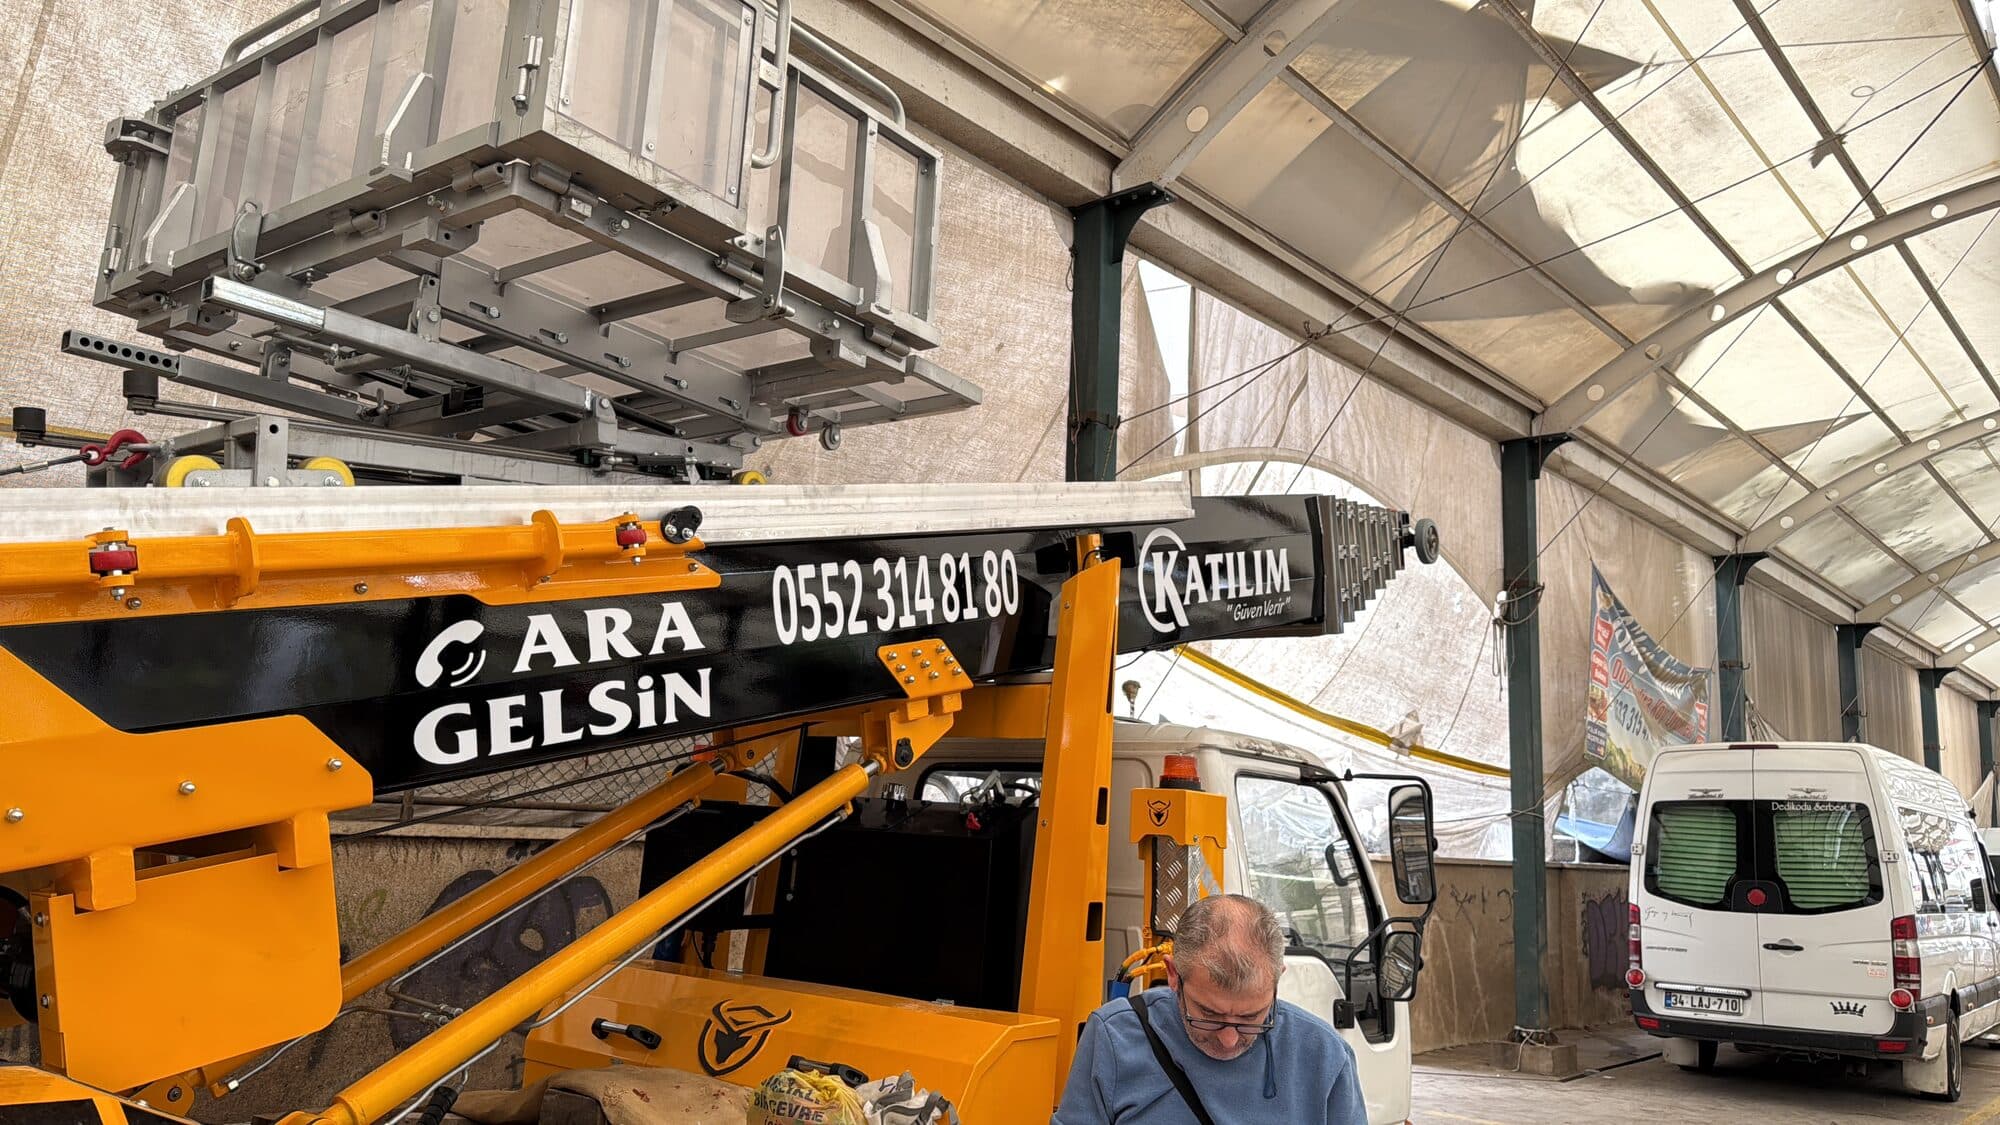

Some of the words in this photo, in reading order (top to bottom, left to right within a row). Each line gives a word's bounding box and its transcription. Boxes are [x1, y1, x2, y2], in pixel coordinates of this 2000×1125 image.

[772, 559, 868, 645] 0552
[873, 555, 934, 631] 314
[939, 552, 979, 623] 81
[982, 549, 1019, 618] 80
[1151, 547, 1291, 628] KATILIM
[1226, 603, 1262, 622] "Güven
[1263, 597, 1291, 619] Verir"
[512, 601, 706, 674] ARA
[1771, 801, 1812, 811] Dedikodu
[1813, 802, 1847, 812] Serbest
[1671, 994, 1684, 1006] 34
[1690, 995, 1711, 1009] LAJ
[1717, 998, 1738, 1011] 710
